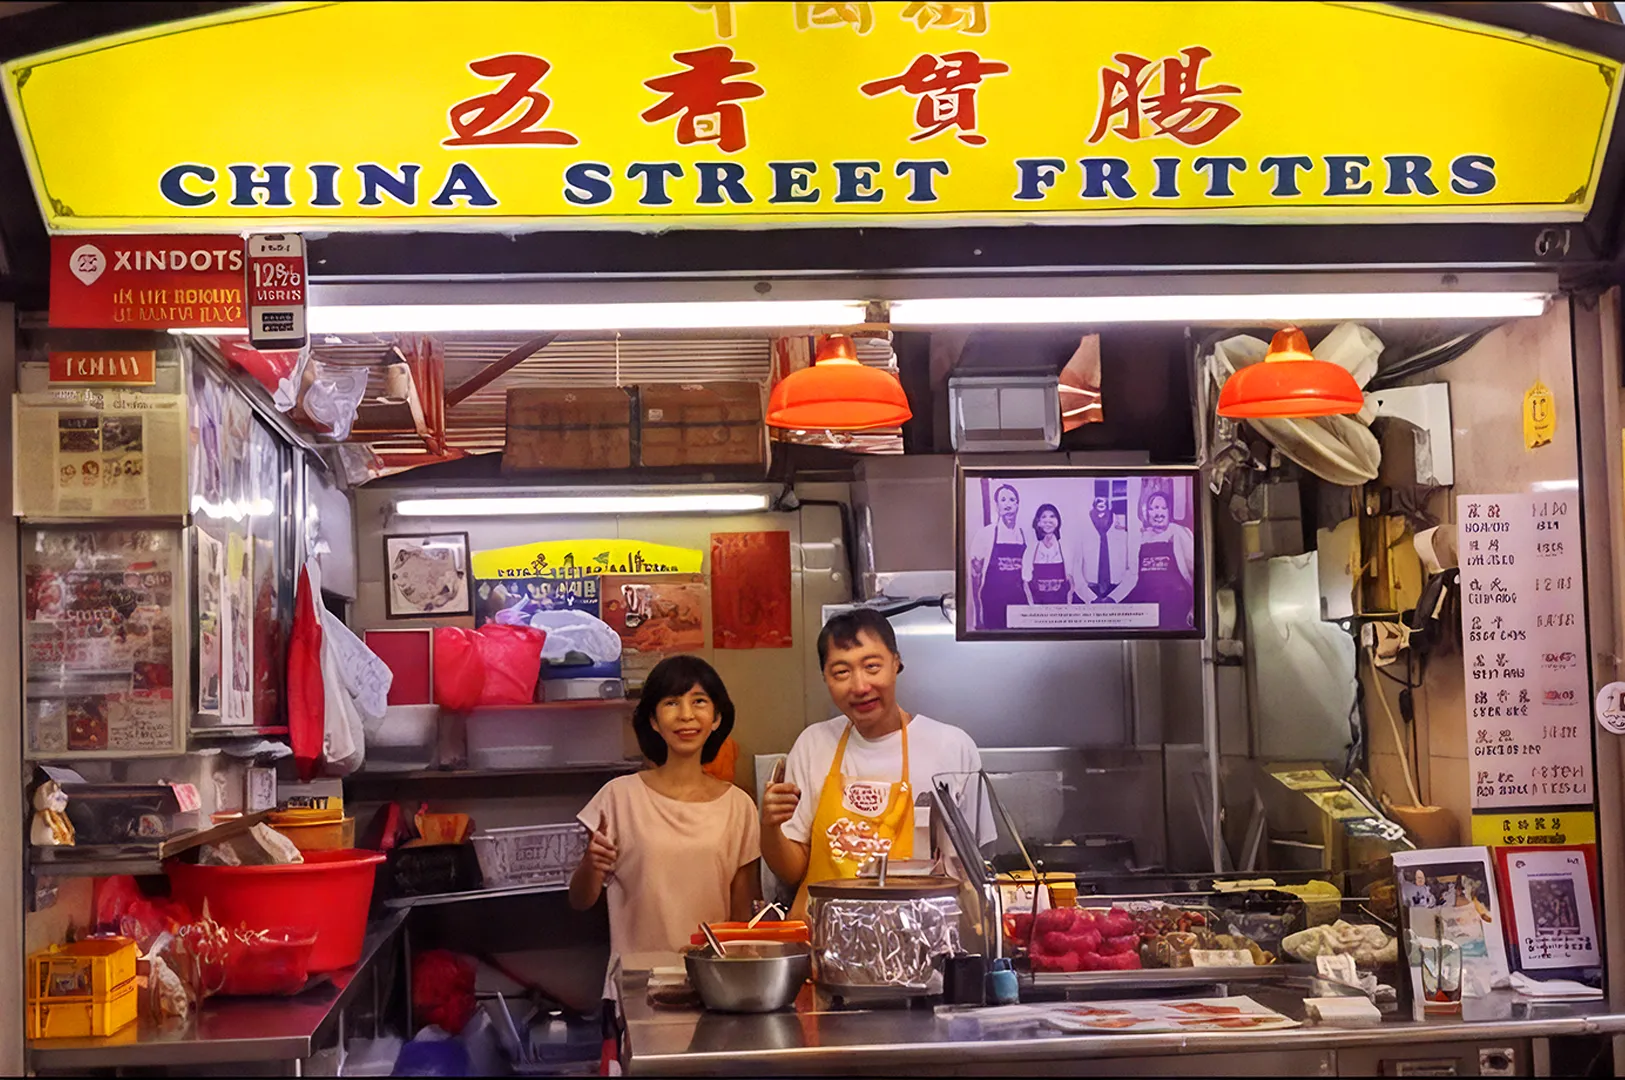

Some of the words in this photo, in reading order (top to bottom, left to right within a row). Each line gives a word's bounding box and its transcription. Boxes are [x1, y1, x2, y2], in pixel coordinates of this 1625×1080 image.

[160, 163, 498, 207] CHINA
[564, 160, 949, 206] STREET
[1013, 155, 1496, 201] FRITTERS
[114, 249, 243, 271] XINDOTS
